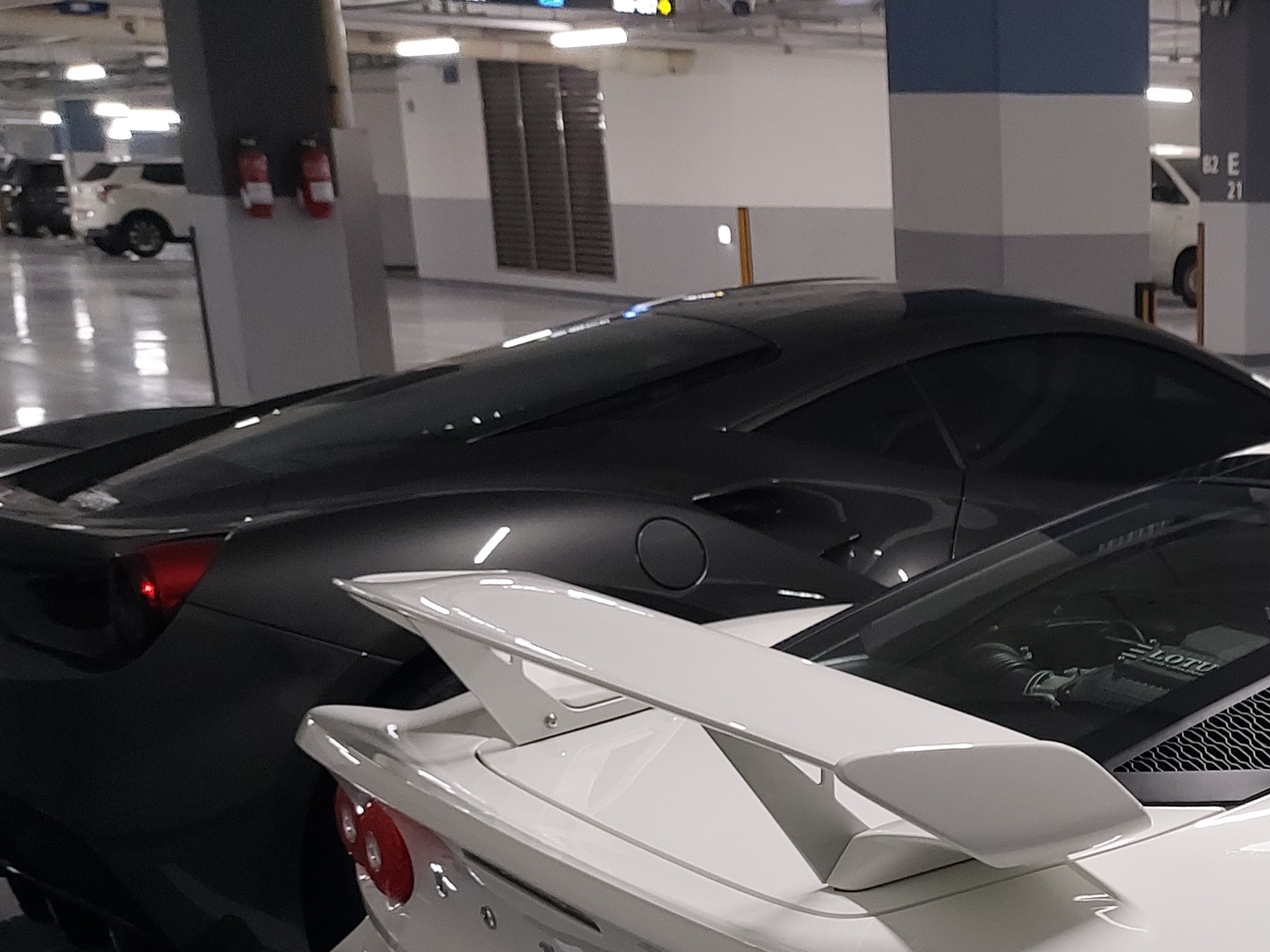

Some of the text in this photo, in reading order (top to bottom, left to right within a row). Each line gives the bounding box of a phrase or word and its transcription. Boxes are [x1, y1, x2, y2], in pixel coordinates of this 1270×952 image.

[1202, 151, 1240, 176] B2 E
[1226, 181, 1242, 200] 21
[1149, 649, 1220, 673] LOTU
